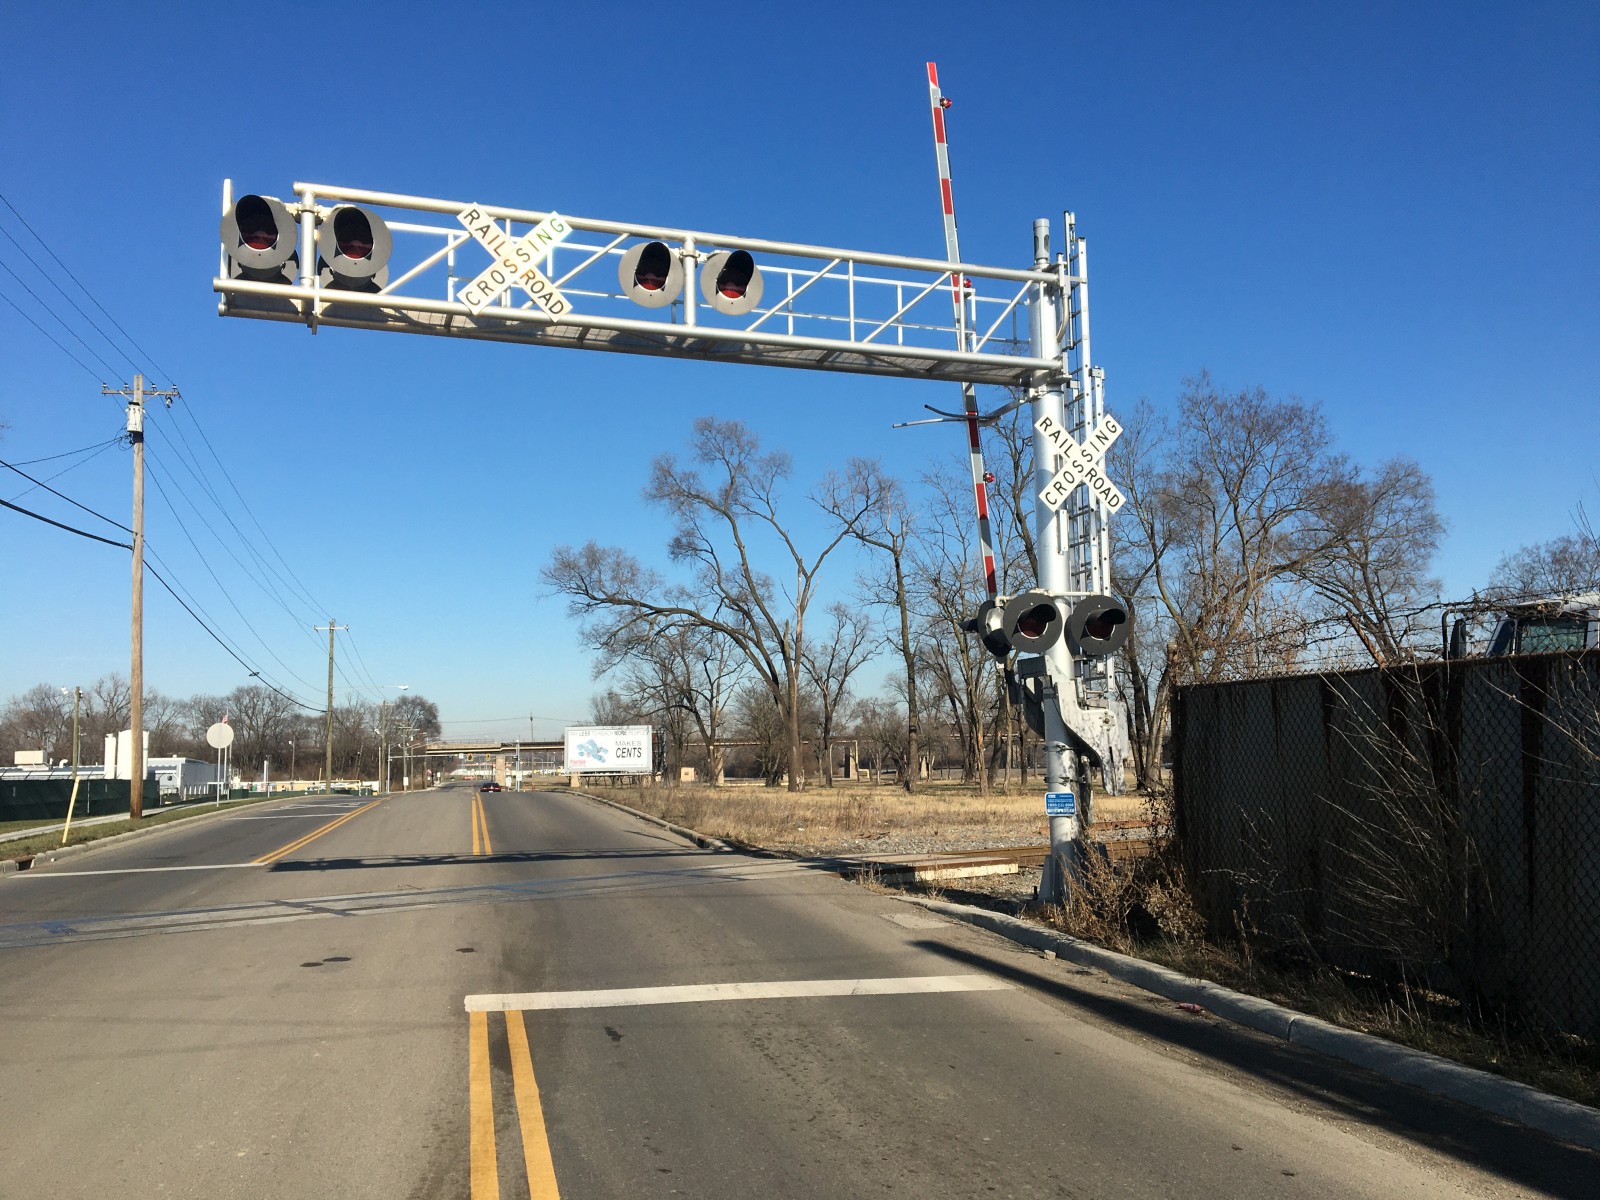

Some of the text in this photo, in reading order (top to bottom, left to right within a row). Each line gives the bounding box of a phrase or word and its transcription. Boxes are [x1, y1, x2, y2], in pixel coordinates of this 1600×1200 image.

[463, 208, 564, 315] RAIL ROAD
[465, 218, 565, 306] CROSSING
[1039, 416, 1120, 507] RAIL ROAD
[1045, 420, 1117, 505] CROSSING
[615, 747, 642, 758] CENTS
